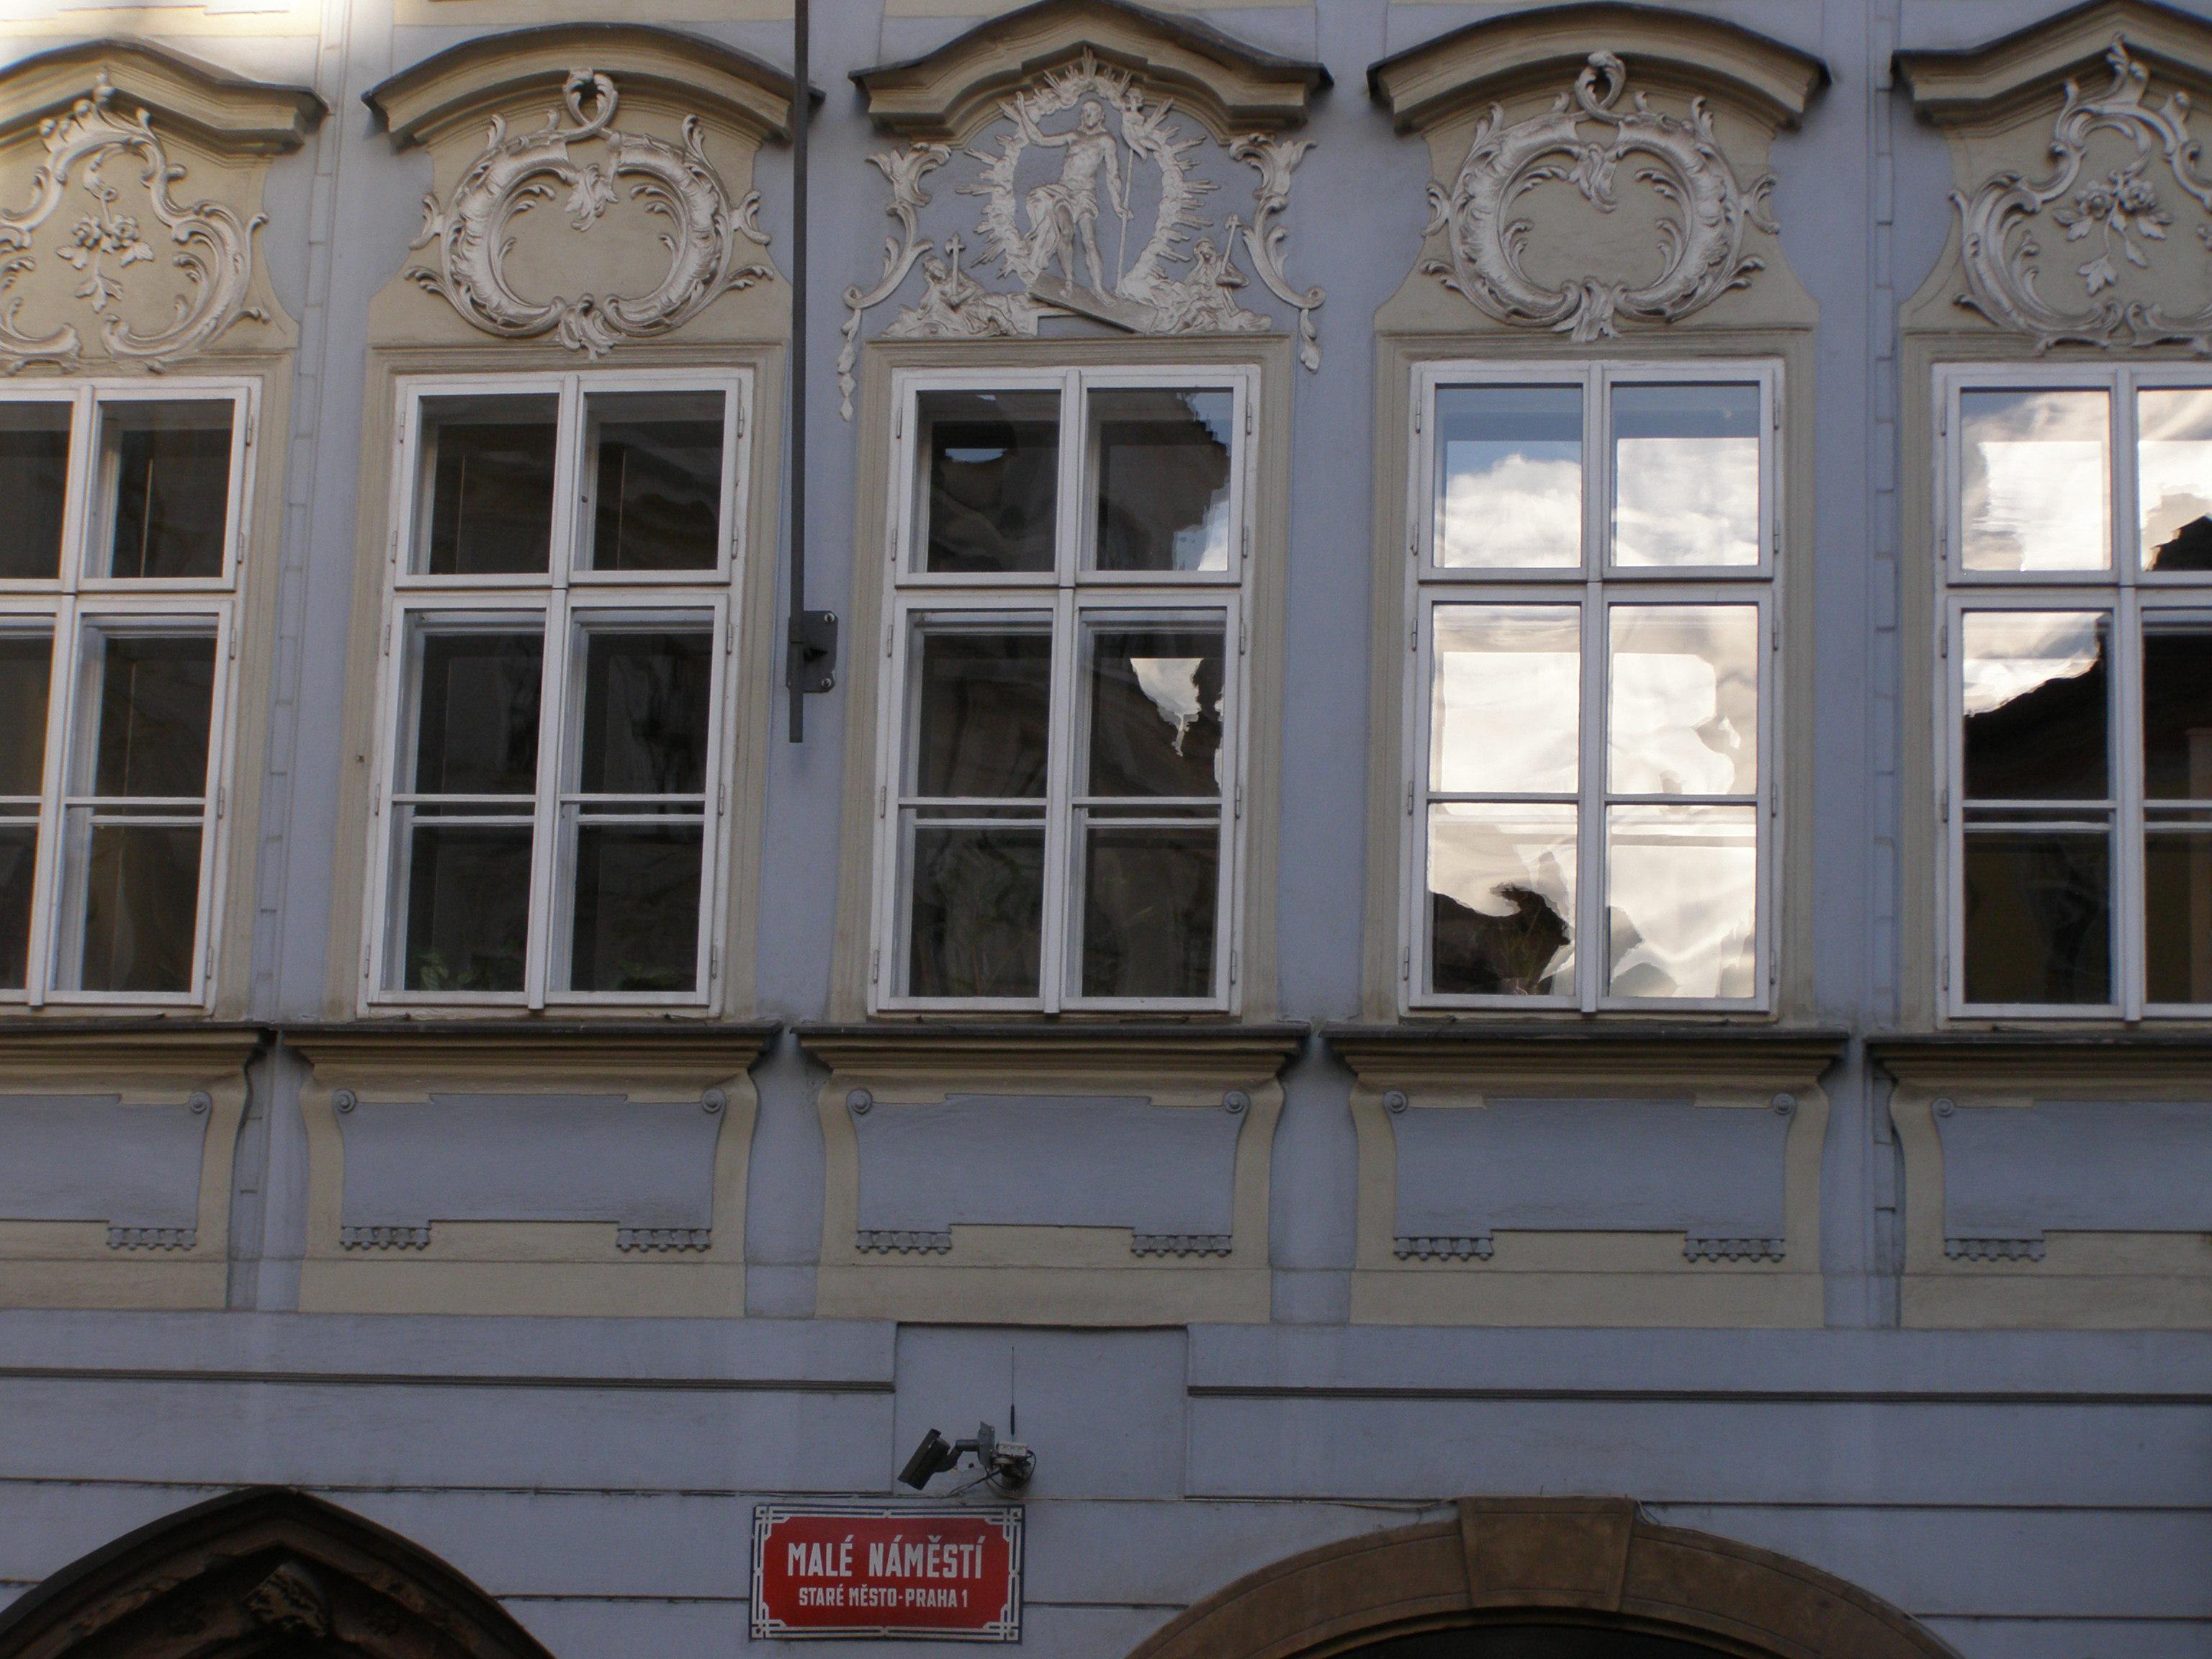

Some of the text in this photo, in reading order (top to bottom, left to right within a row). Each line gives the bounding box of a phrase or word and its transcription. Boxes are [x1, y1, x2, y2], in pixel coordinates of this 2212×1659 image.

[787, 1534, 986, 1579] MALÉ NÁMĚSTÍ
[799, 1583, 844, 1606] STARÉ
[961, 1589, 968, 1608] 1
